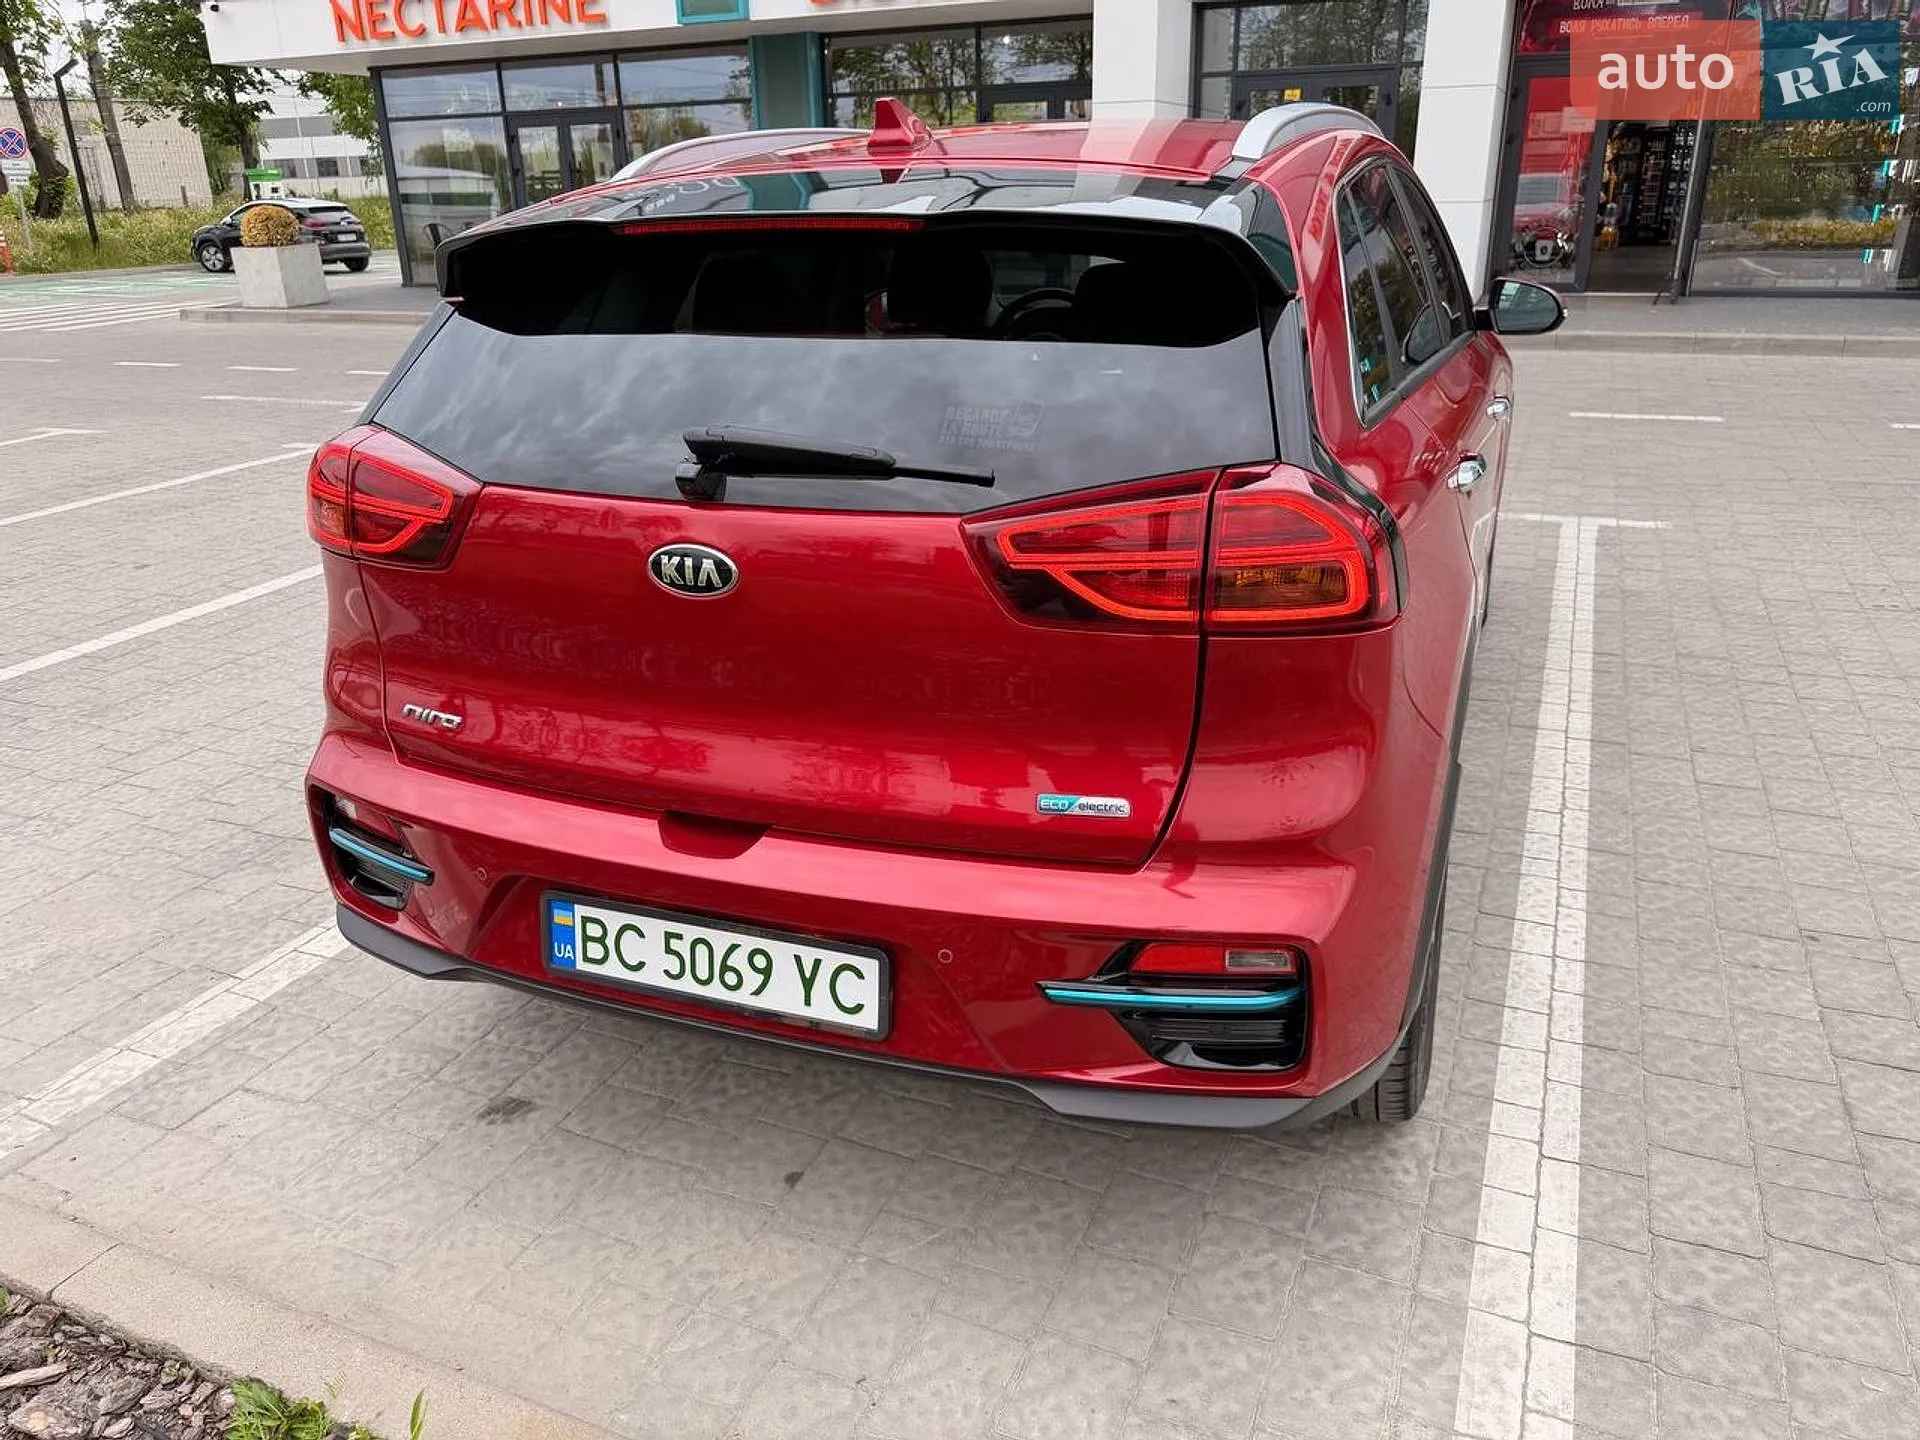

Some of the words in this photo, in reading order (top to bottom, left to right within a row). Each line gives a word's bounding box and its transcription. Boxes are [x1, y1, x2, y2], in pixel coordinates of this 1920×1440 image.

[329, 0, 606, 42] NECTARINE
[660, 554, 723, 588] KIA
[1041, 799, 1069, 809] ECO
[1078, 802, 1126, 813] electric
[554, 941, 575, 961] UA
[580, 915, 647, 973] BC
[663, 930, 774, 996] 5069
[793, 953, 866, 1016] YC
